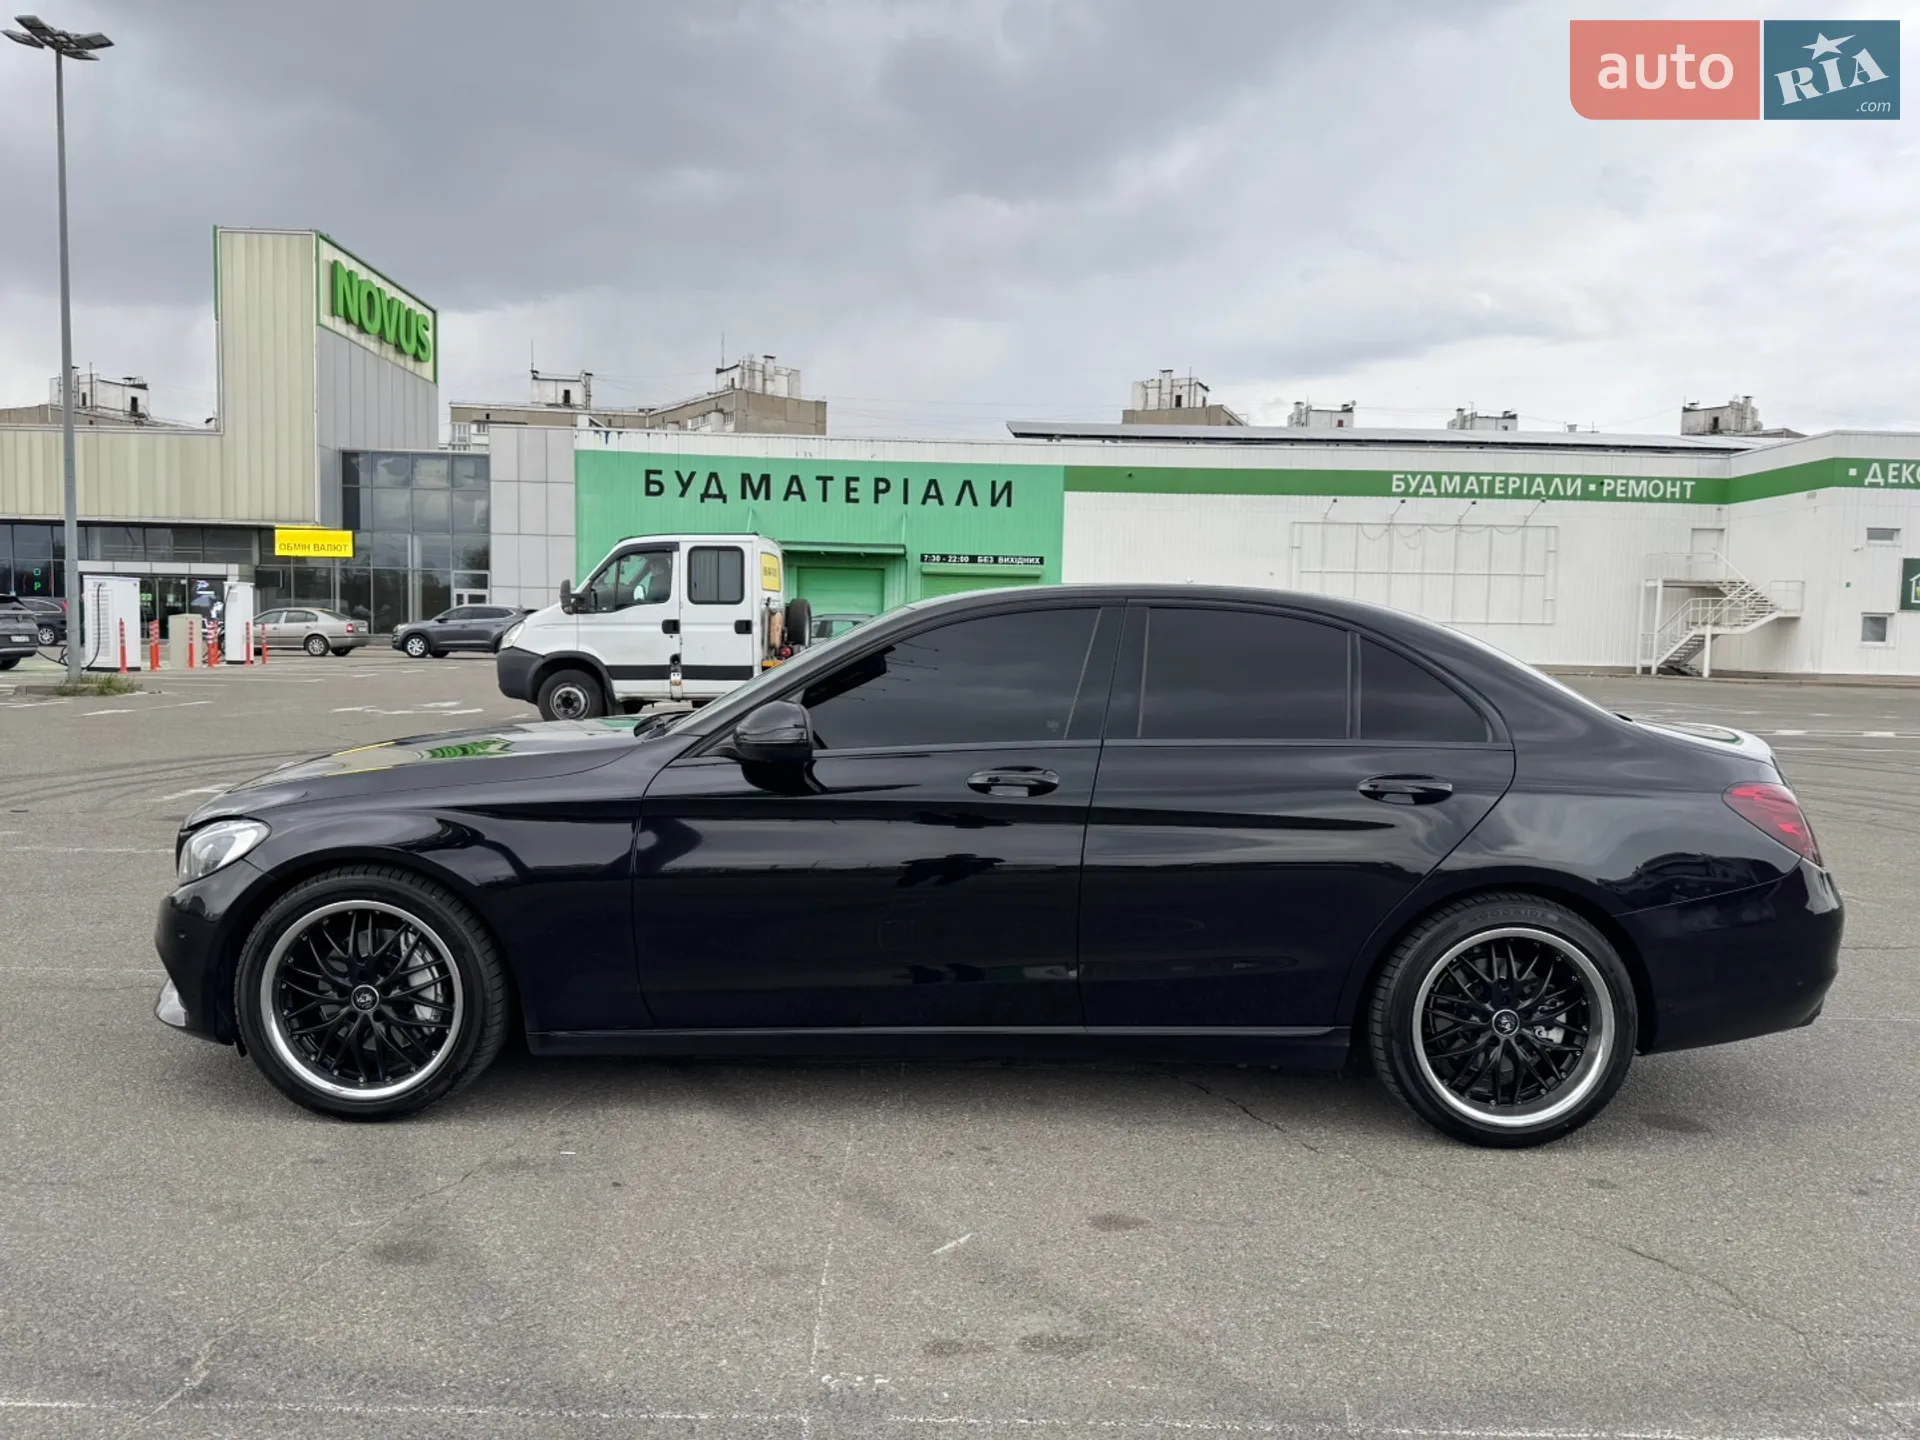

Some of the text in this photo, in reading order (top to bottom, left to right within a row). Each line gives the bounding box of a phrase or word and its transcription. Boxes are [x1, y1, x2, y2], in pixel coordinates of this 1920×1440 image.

[331, 259, 431, 362] NOVUS
[1391, 474, 1696, 499] БУДМАТЕРІАЛИ РЕМОНТ
[1864, 463, 1920, 486] ДЕК
[644, 469, 1013, 508] БУДМАТЕРІАЛИ
[279, 542, 348, 552] ОБМІН ВАЛЮТ
[923, 555, 941, 563] 7:30
[977, 556, 994, 564] БЕЗ
[998, 557, 1041, 565] ВИХІДНИХ
